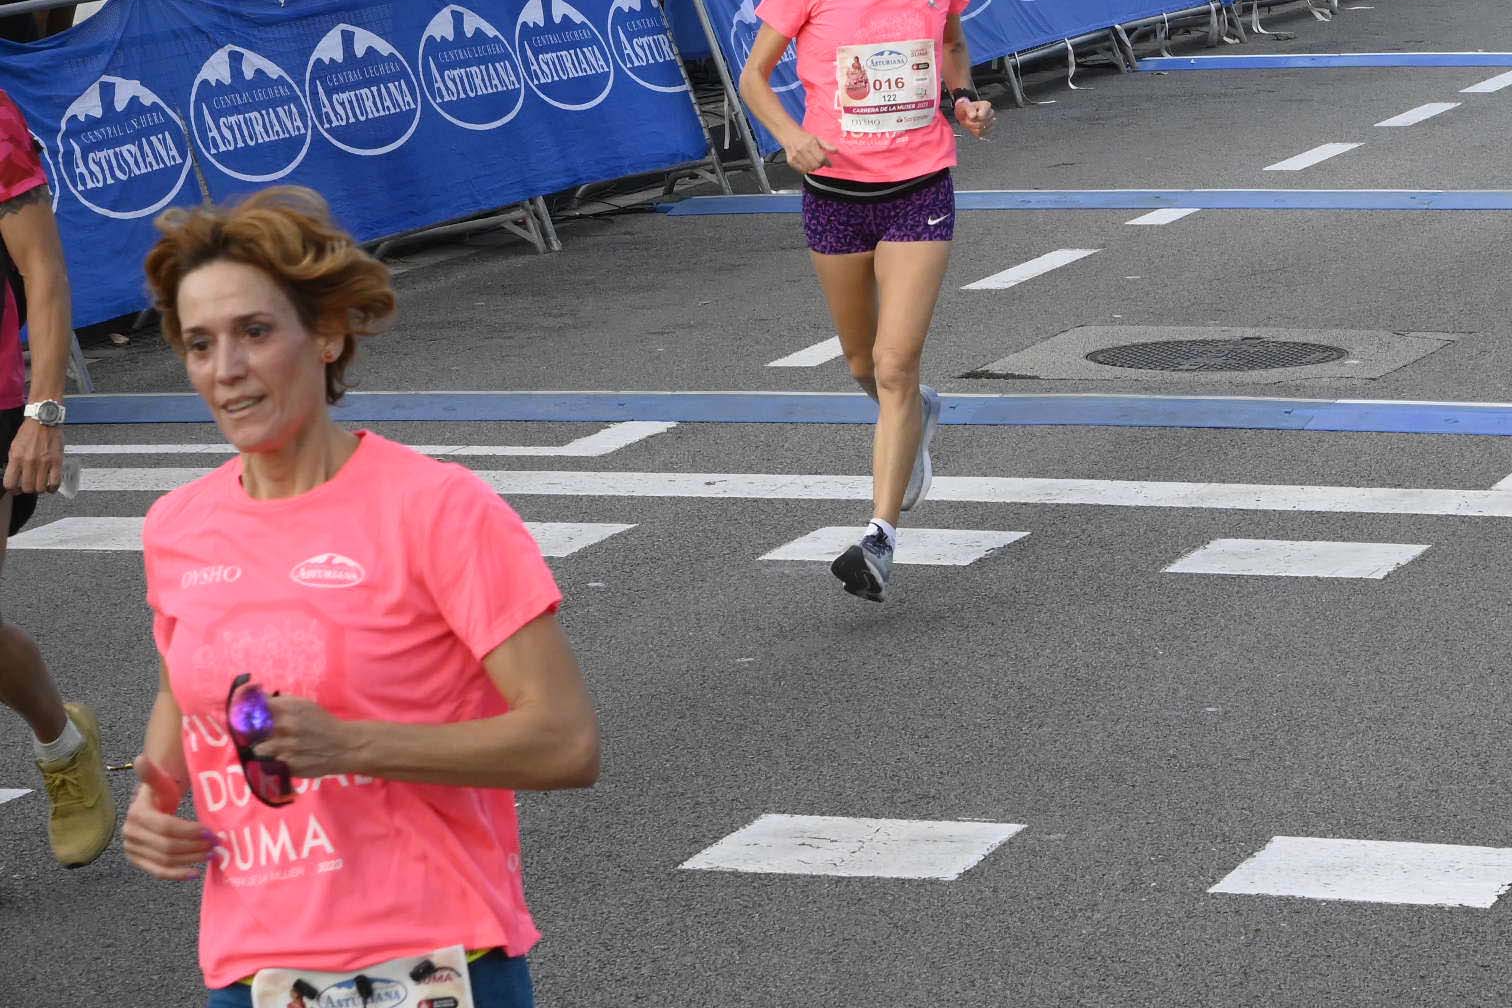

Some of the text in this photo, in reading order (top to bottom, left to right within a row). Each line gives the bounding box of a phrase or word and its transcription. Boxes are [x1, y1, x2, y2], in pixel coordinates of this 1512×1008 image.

[524, 41, 610, 85] ASTURIANA
[618, 25, 680, 68] ASTUR
[326, 69, 361, 87] CENTRAL
[429, 56, 520, 103] ASTURIANA
[873, 76, 905, 91] 016
[882, 94, 897, 102] 122
[213, 91, 252, 109] CENTRAL
[317, 78, 416, 128] ASTURIANA
[202, 102, 306, 155] ASTURIANA
[70, 131, 182, 192] ASTURIANA
[182, 565, 241, 589] OYSHO
